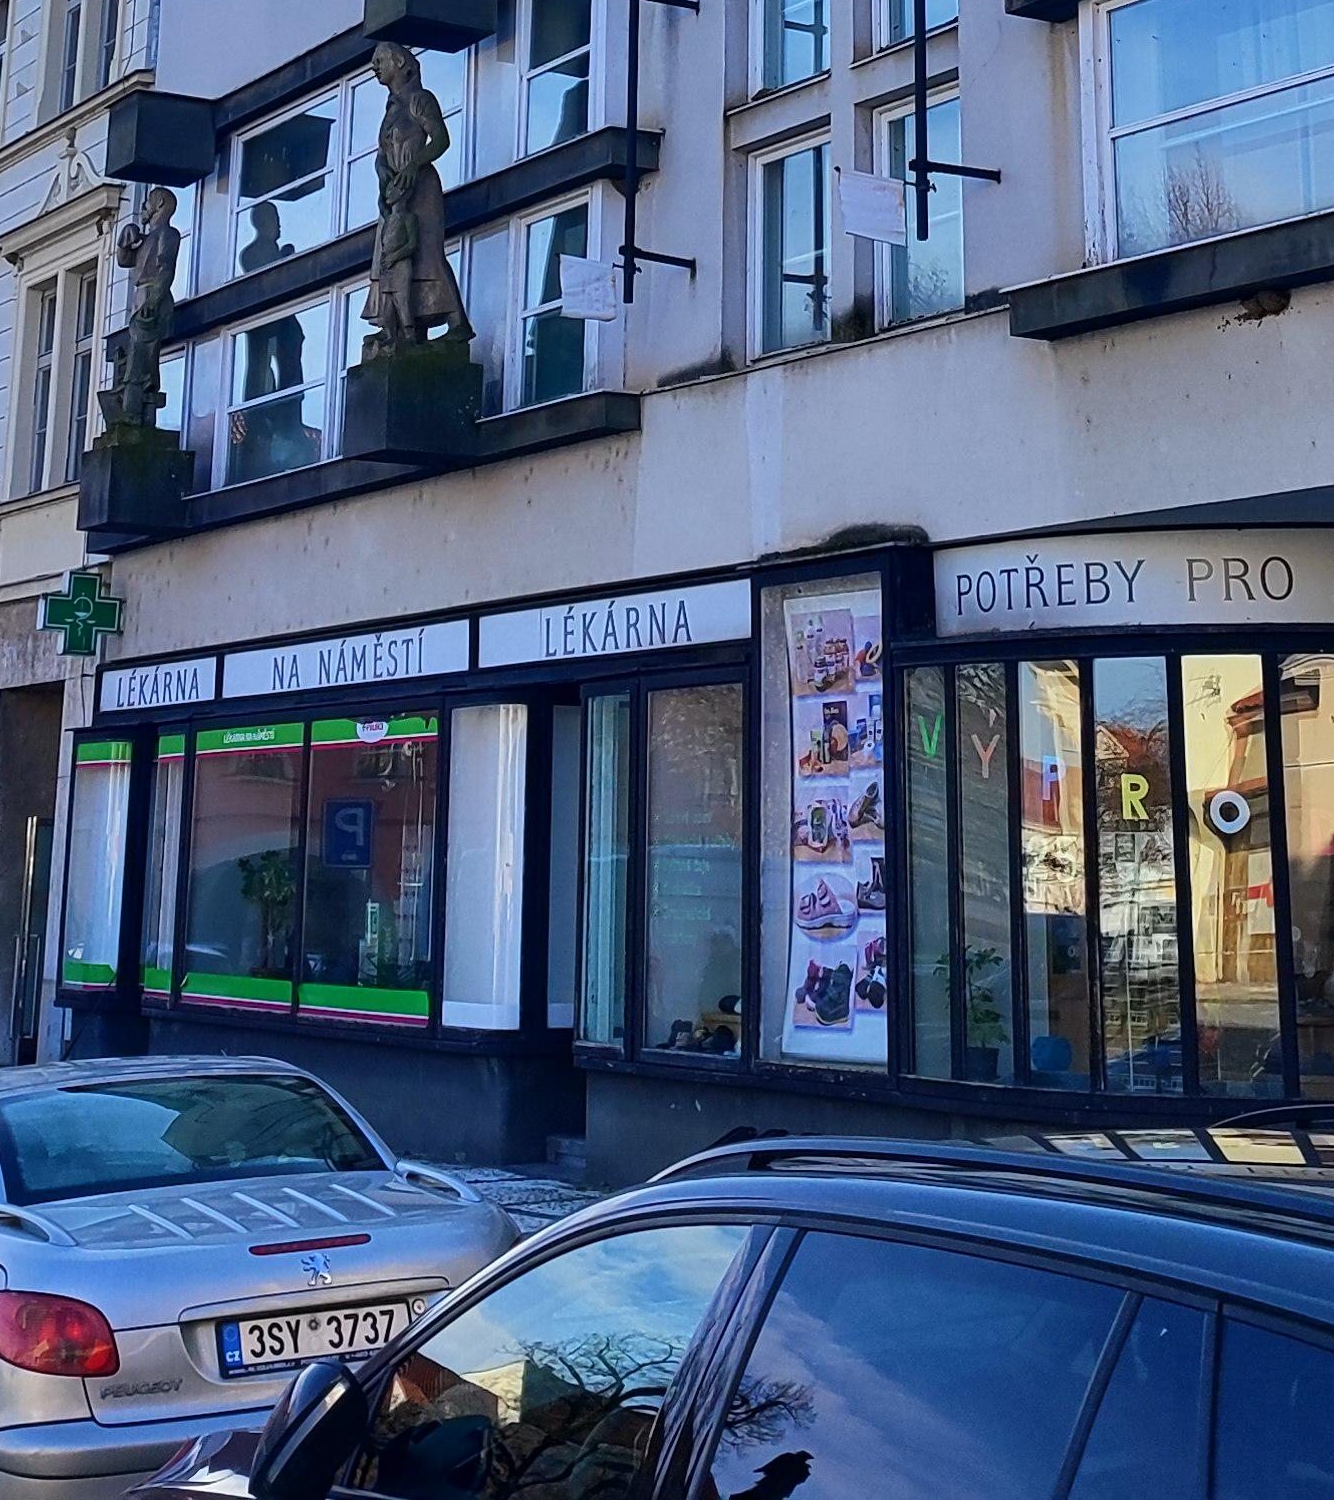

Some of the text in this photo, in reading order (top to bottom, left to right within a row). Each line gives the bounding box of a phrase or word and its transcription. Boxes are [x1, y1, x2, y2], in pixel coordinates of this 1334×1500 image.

[955, 553, 1146, 617] POTŘEBY
[1185, 555, 1295, 603] PRO
[545, 599, 693, 658] LÉKÁRNA
[115, 627, 425, 708] LÉKÁRNA NA NÁMĚSTÍ
[225, 1350, 241, 1362] CZ
[248, 1308, 395, 1358] 3SY 3737
